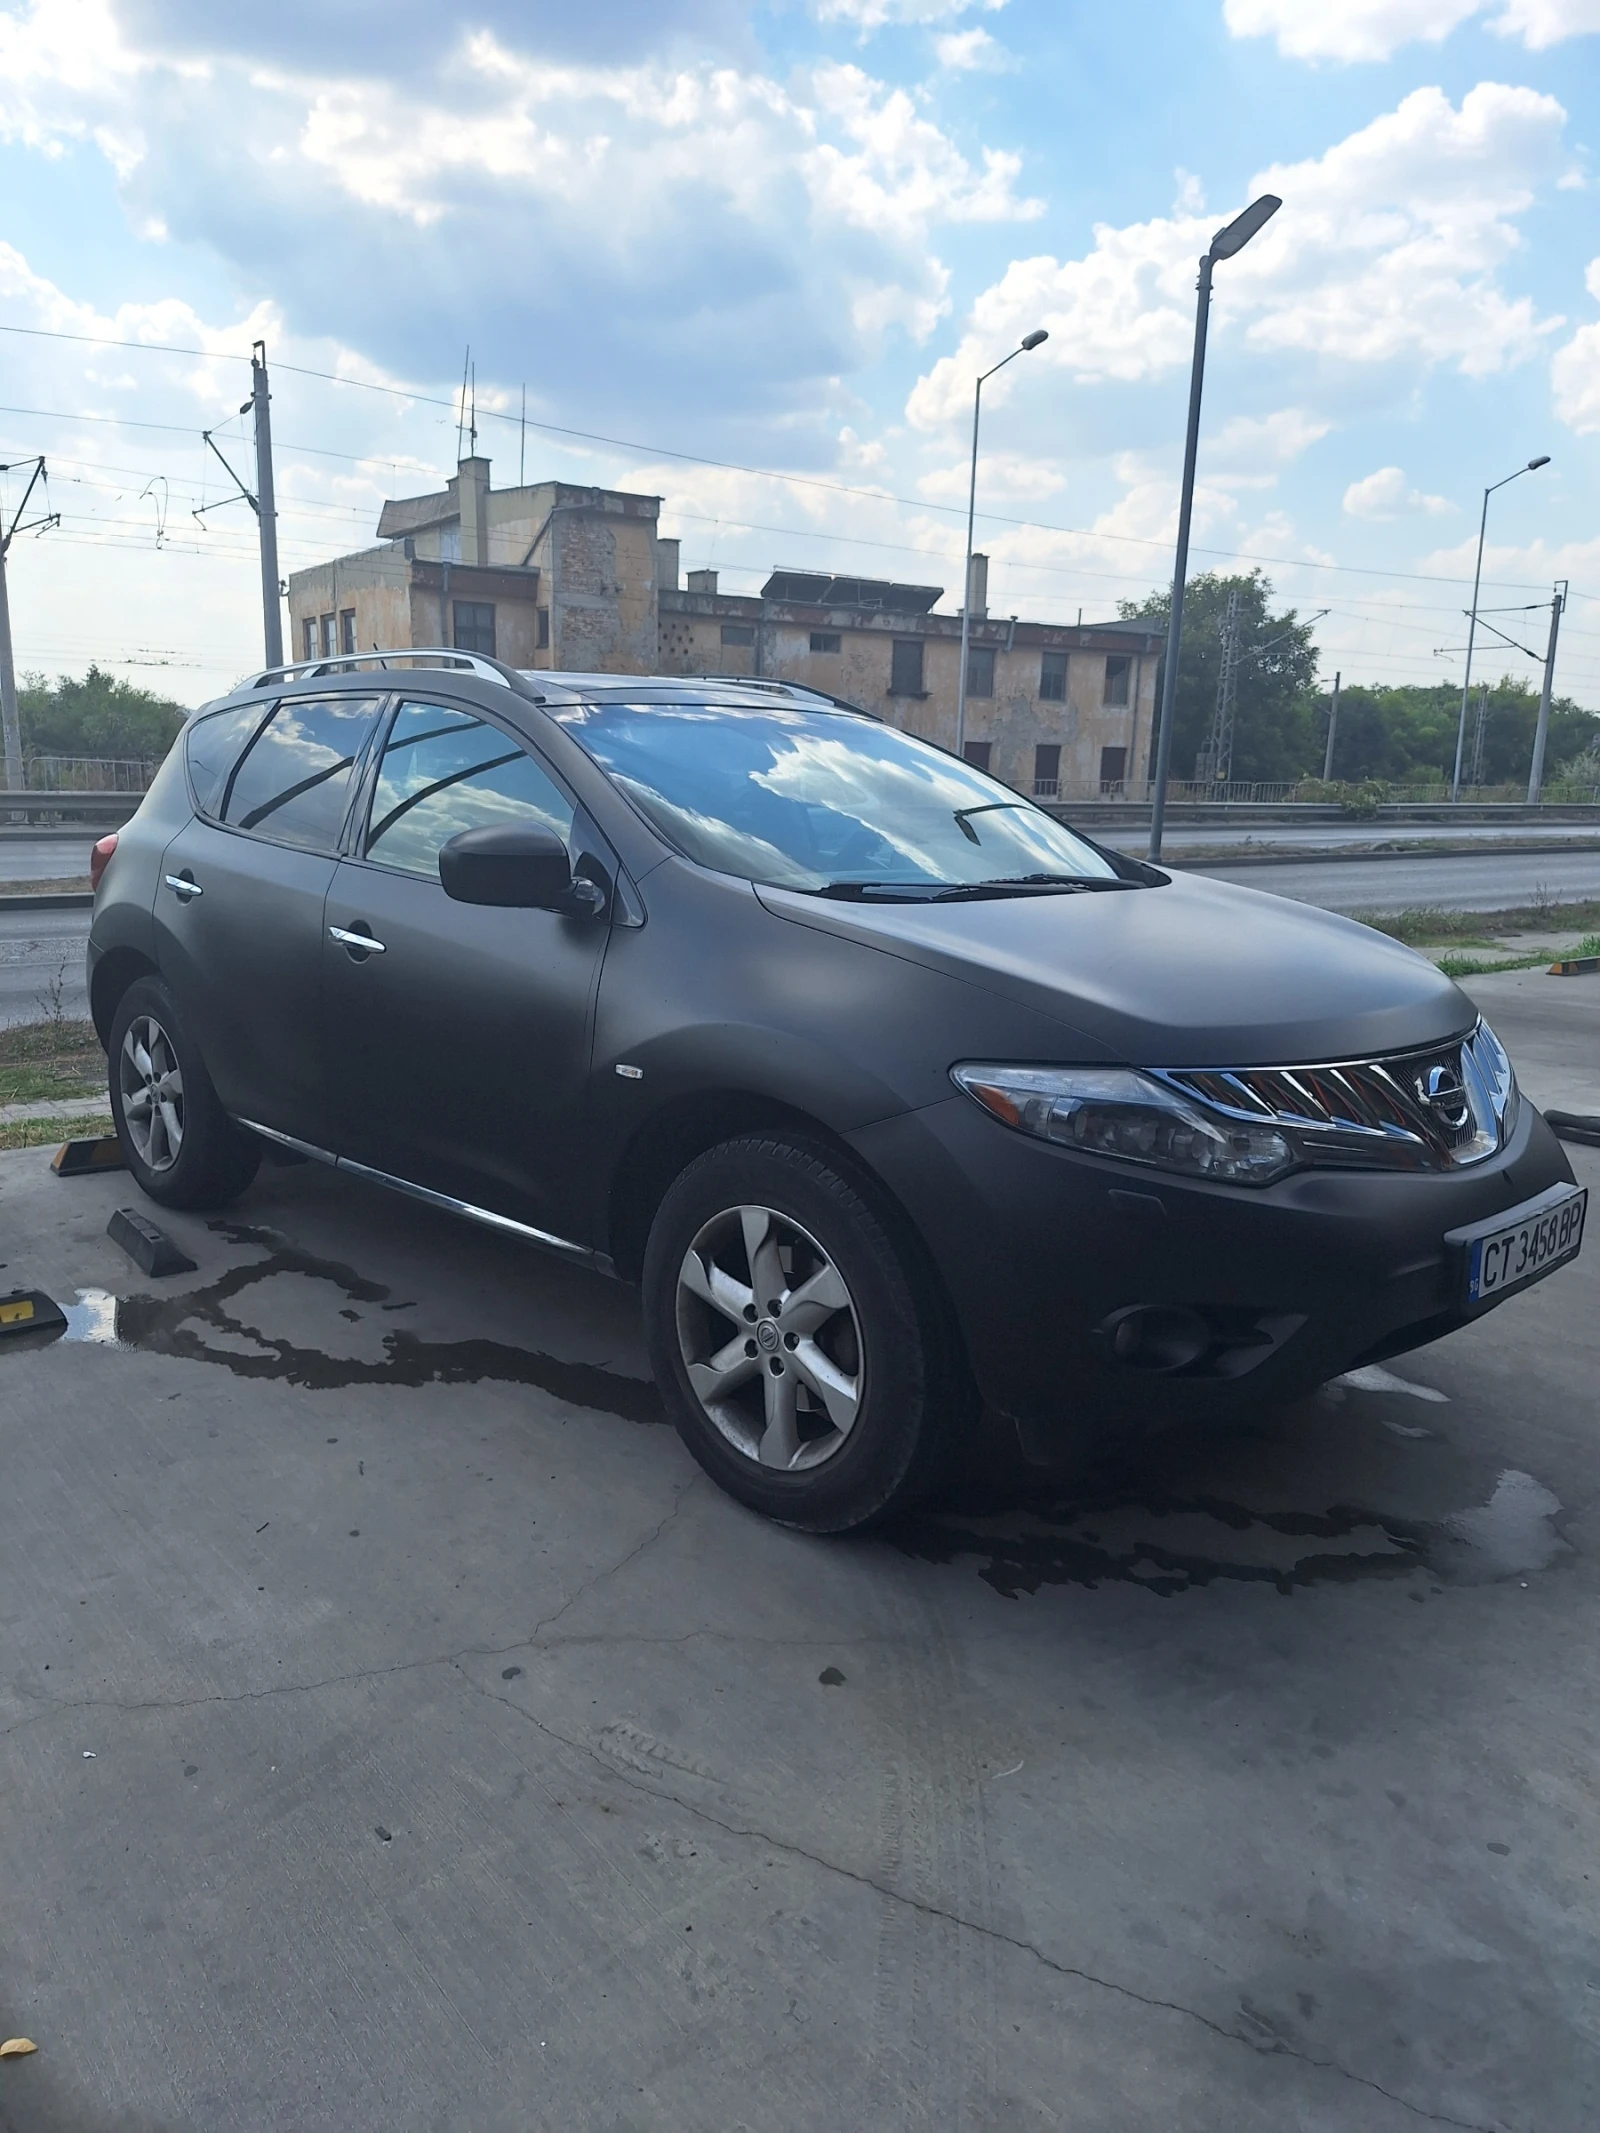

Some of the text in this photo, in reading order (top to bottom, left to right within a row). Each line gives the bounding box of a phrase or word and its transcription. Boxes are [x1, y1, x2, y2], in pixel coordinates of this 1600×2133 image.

[1484, 1201, 1581, 1288] CT 3458 BP
